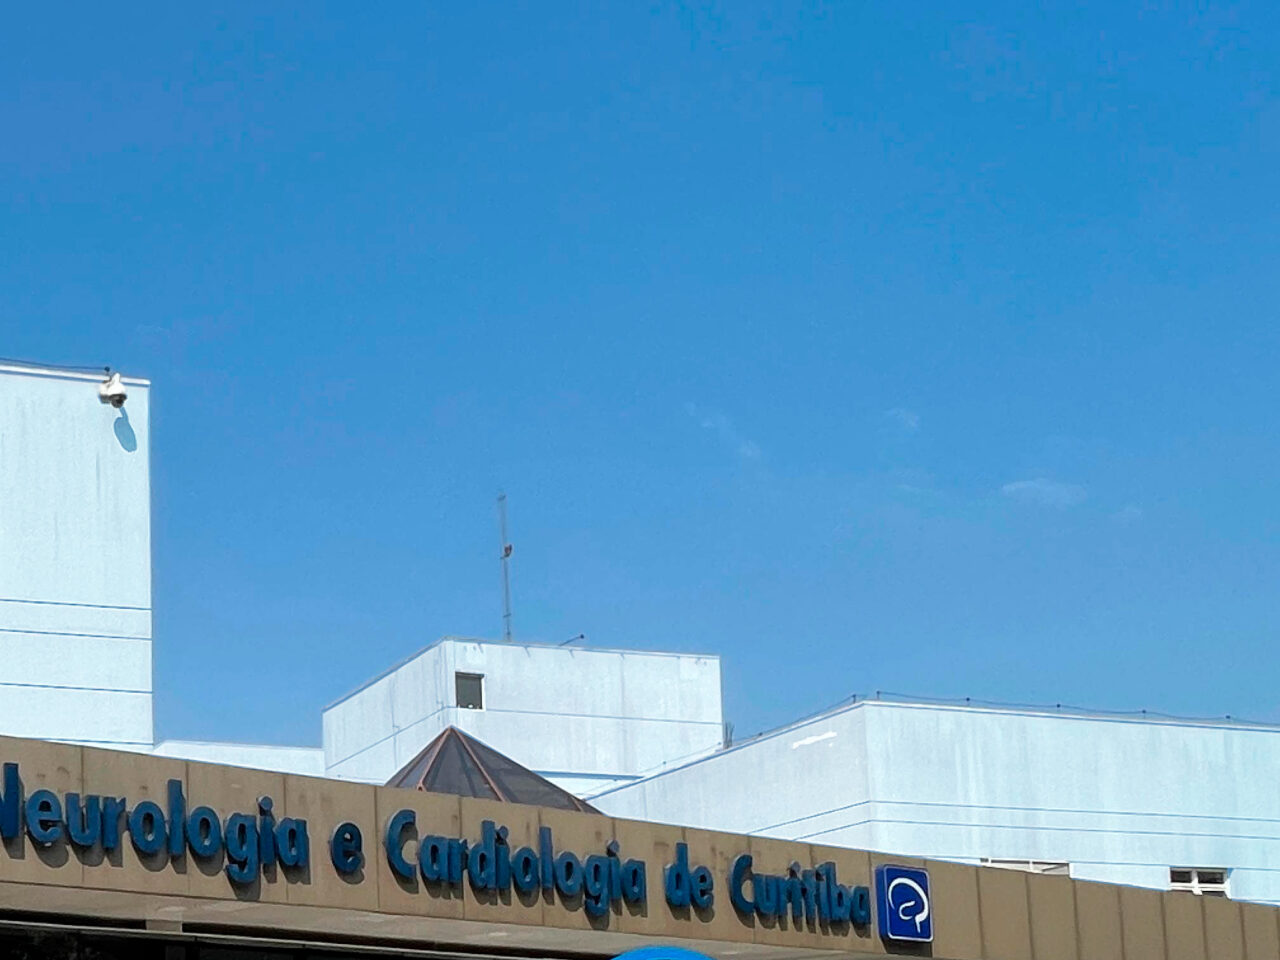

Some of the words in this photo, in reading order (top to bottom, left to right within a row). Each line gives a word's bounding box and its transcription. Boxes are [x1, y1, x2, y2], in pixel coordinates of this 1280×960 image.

[330, 820, 363, 874] e
[385, 808, 646, 916] Cardiologia
[664, 842, 714, 908] de
[730, 854, 871, 924] Curitiba
